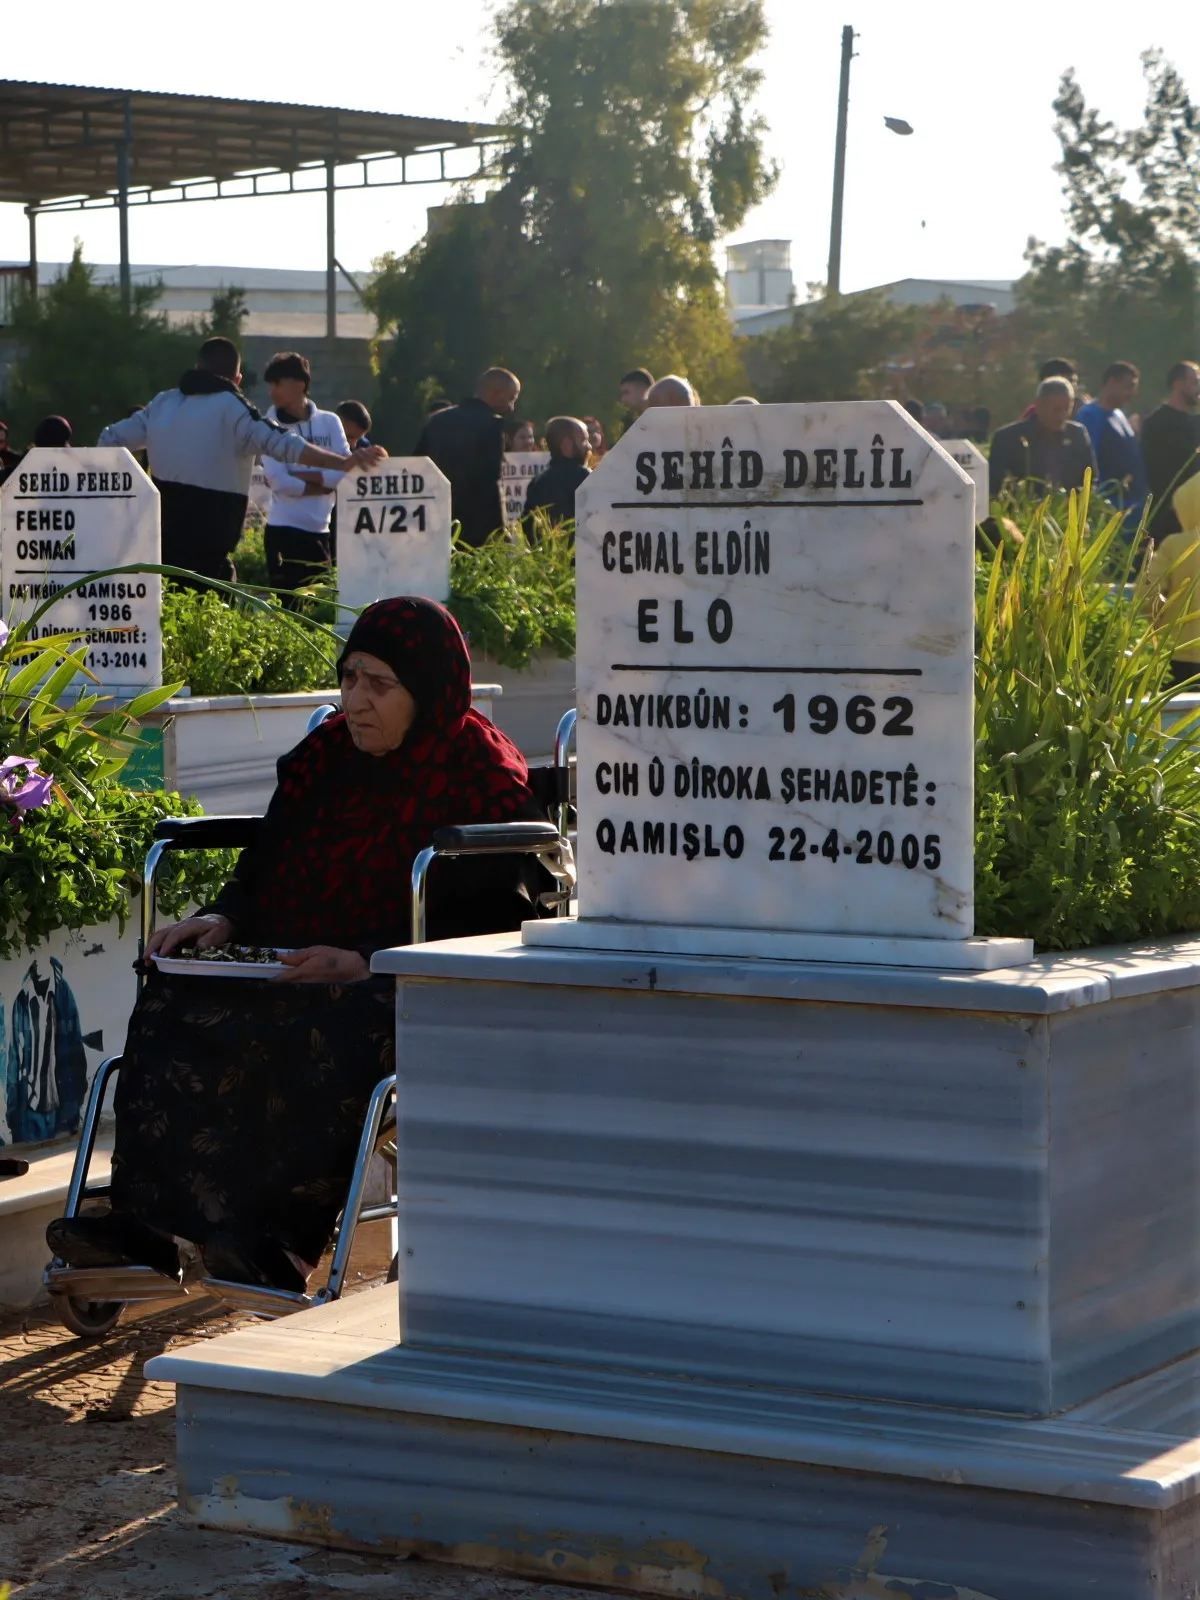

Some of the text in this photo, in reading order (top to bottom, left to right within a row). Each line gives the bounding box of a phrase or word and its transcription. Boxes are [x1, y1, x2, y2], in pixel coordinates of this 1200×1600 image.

[636, 434, 912, 495] ŞEHÎD DELÎL
[19, 466, 133, 494] ŞEHÎD FEHED
[357, 468, 425, 498] ŞEHÎD
[16, 510, 76, 531] FEHED
[354, 504, 426, 534] A/21
[16, 539, 76, 561] OSMAN
[602, 520, 770, 575] CEMAL ELDÎN
[76, 583, 147, 600] QAMIŞLO
[88, 604, 132, 621] 1986
[772, 693, 914, 736] 1962
[595, 761, 639, 797] CIH
[649, 756, 665, 797] Û
[674, 757, 772, 800] DÎROKA
[596, 818, 942, 870] QAMIŞLO 22-4-2005
